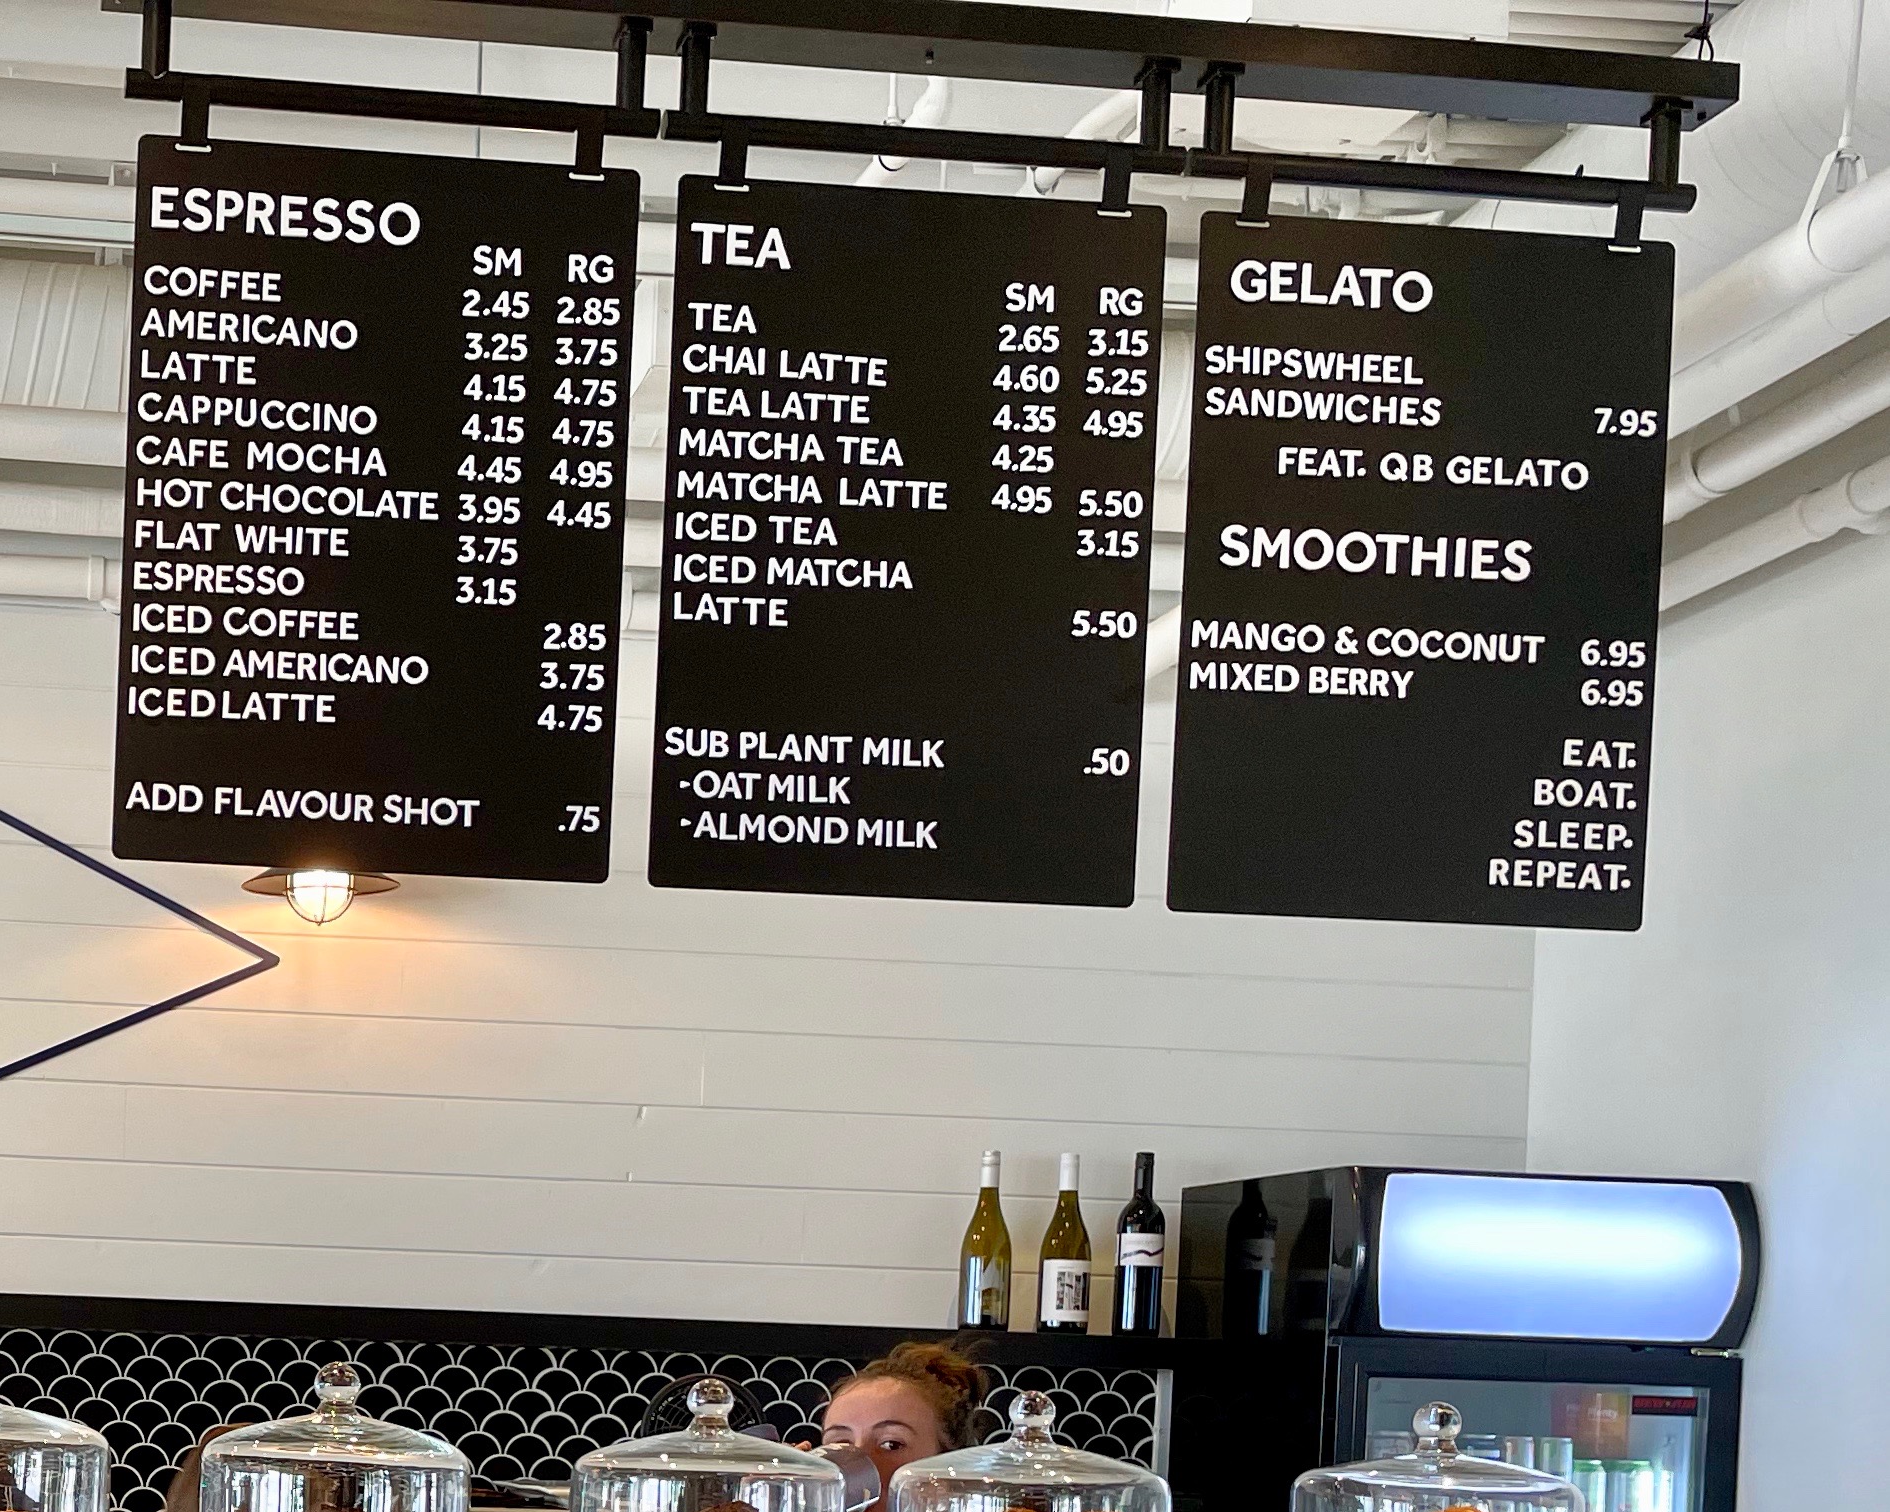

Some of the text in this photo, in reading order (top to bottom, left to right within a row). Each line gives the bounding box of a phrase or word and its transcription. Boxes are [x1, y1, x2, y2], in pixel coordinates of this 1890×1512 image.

[151, 186, 420, 245] ESPRESSO
[473, 246, 613, 283] SM RG
[693, 223, 791, 269] TEA
[144, 265, 620, 325] COFFEE 2.45 2.85
[1006, 283, 1143, 316] SM RG
[1231, 260, 1433, 312] GELATO
[141, 308, 357, 349] AMERICANO
[692, 303, 1148, 356] TEA 2.65 3.15
[141, 350, 256, 384] LATTE
[683, 344, 887, 386] CHAI LATTE
[1206, 345, 1423, 384] SHIPSWHEEL
[138, 393, 377, 434] CAPPUCCINO
[685, 386, 869, 423] TEA LATTE
[1205, 387, 1657, 436] SANDWICHES 7.95
[137, 436, 386, 476] CAFE MOCHA
[679, 428, 903, 466] MATCHA TEA
[1279, 447, 1366, 477] FEAT.
[1446, 456, 1588, 490] GELATO
[137, 478, 438, 520] HOT CHOCOLATE
[677, 471, 947, 509] MATCHA LATTE
[135, 520, 348, 556] FLAT WHITE
[675, 512, 837, 545] ICED TEA
[674, 554, 913, 589] ICED MATCHA
[1220, 525, 1532, 581] SMOOTHIES
[134, 561, 304, 596] ESPRESSO
[133, 603, 358, 640] ICED COFFEE
[674, 592, 787, 626] LATTE
[1192, 620, 1645, 667] MANGO & COCONUT 6.95
[132, 645, 428, 684] ICED AMERICANO
[1190, 662, 1643, 706] MIXED BERRY 6.95
[129, 687, 335, 722] ICED LATTE
[665, 727, 1129, 775] SUB PLANT MILK .50
[1563, 739, 1636, 768] EAT.
[127, 782, 599, 832] ADD FLAVOUR SHOT .75
[768, 774, 850, 804] MILK
[1534, 779, 1636, 809] BOAT.
[857, 819, 937, 848] MILK
[1514, 820, 1632, 850] SLEEP.
[1489, 859, 1630, 890] REPEAT.
